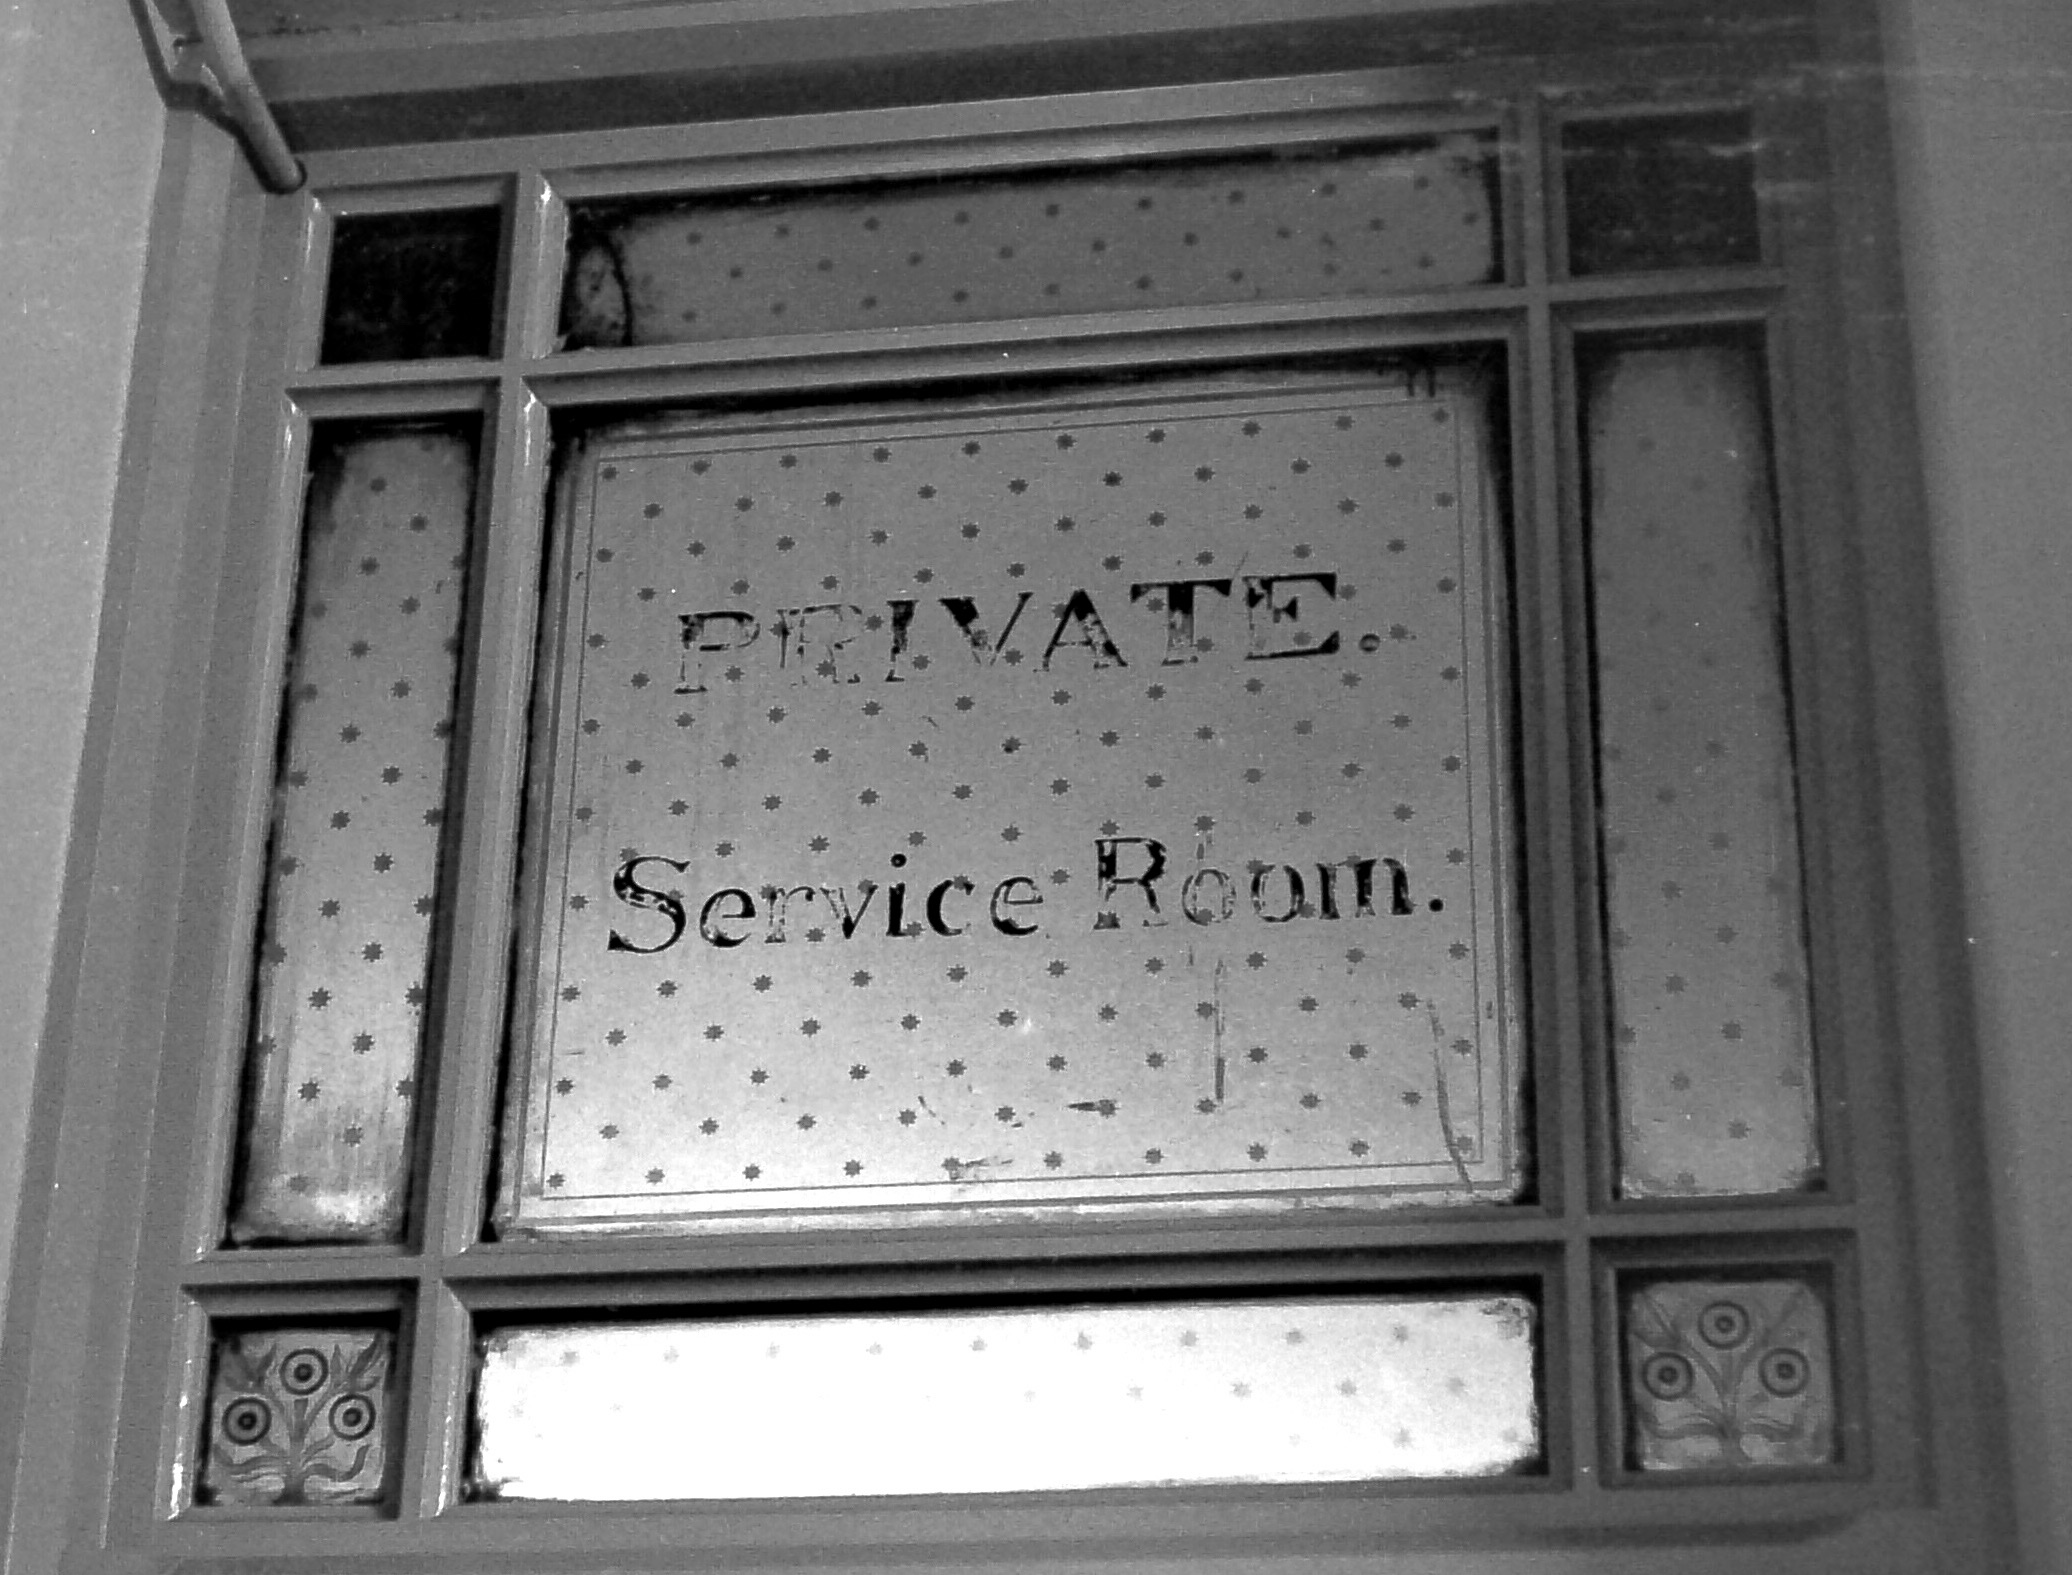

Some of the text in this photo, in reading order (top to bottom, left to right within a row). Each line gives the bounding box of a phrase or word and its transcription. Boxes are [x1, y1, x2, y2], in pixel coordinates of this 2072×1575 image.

[673, 571, 1381, 694] PRIVATE.
[606, 836, 1445, 953] Service Room.
